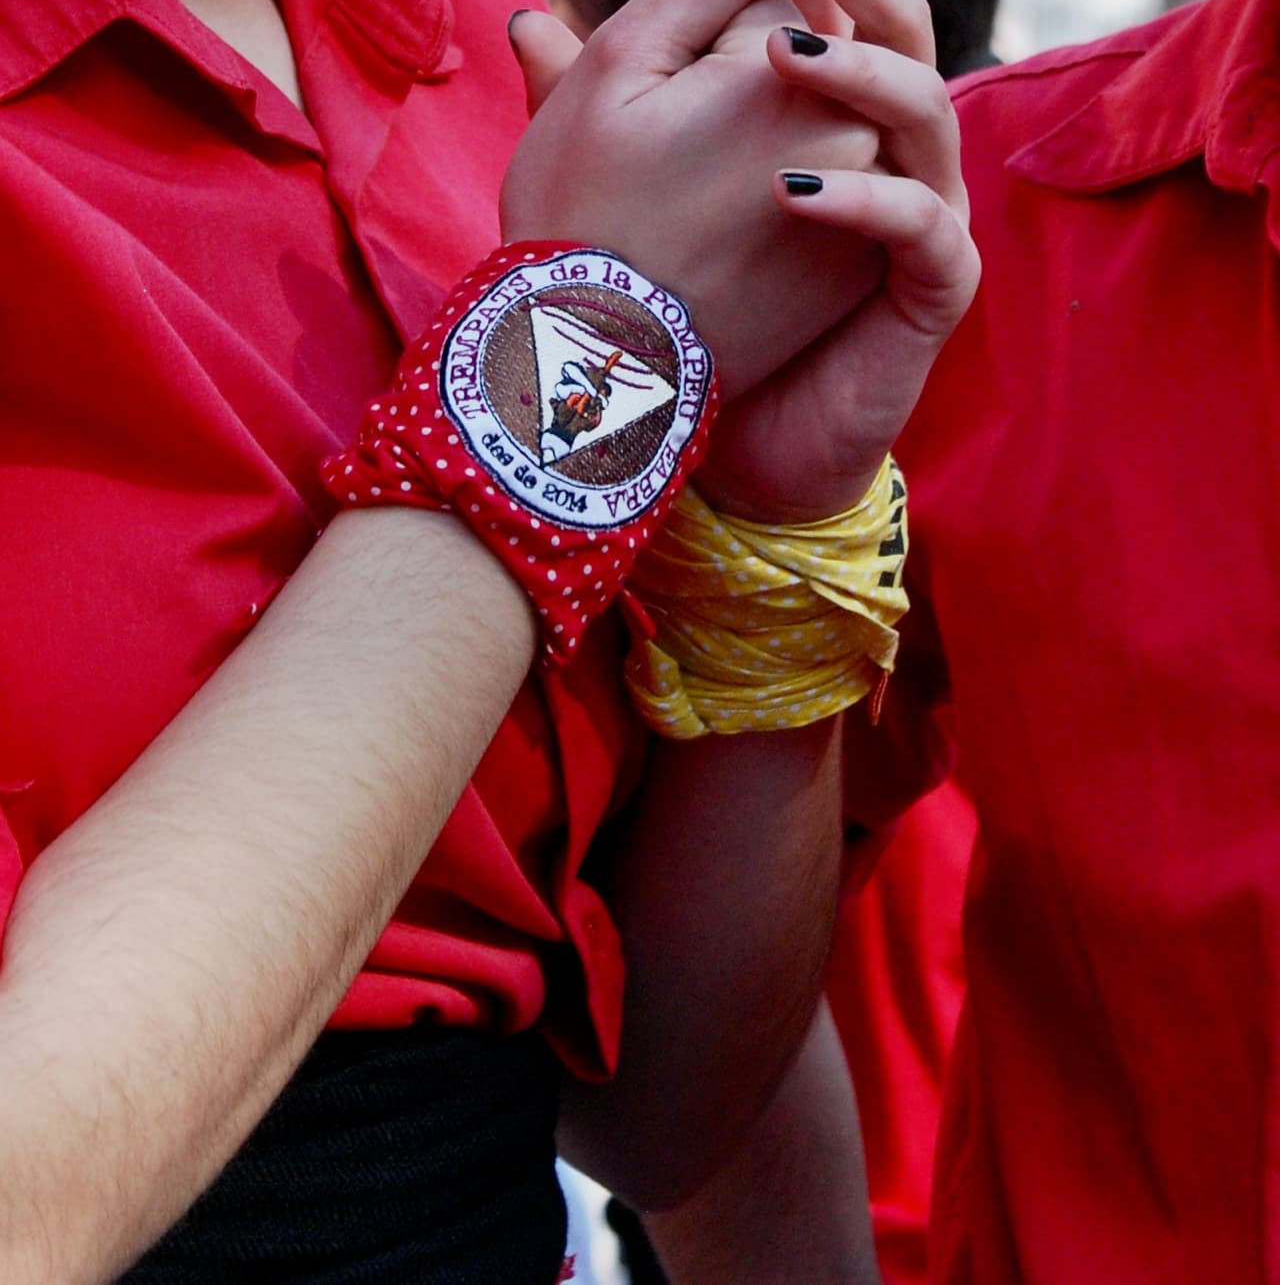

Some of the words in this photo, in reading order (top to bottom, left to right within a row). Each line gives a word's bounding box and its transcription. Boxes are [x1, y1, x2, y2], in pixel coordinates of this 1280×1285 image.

[450, 273, 532, 419] TREMPATS
[549, 263, 588, 281] de
[603, 261, 632, 292] la
[642, 286, 705, 423] POMPEU
[514, 465, 538, 489] de
[542, 483, 587, 513] 2014
